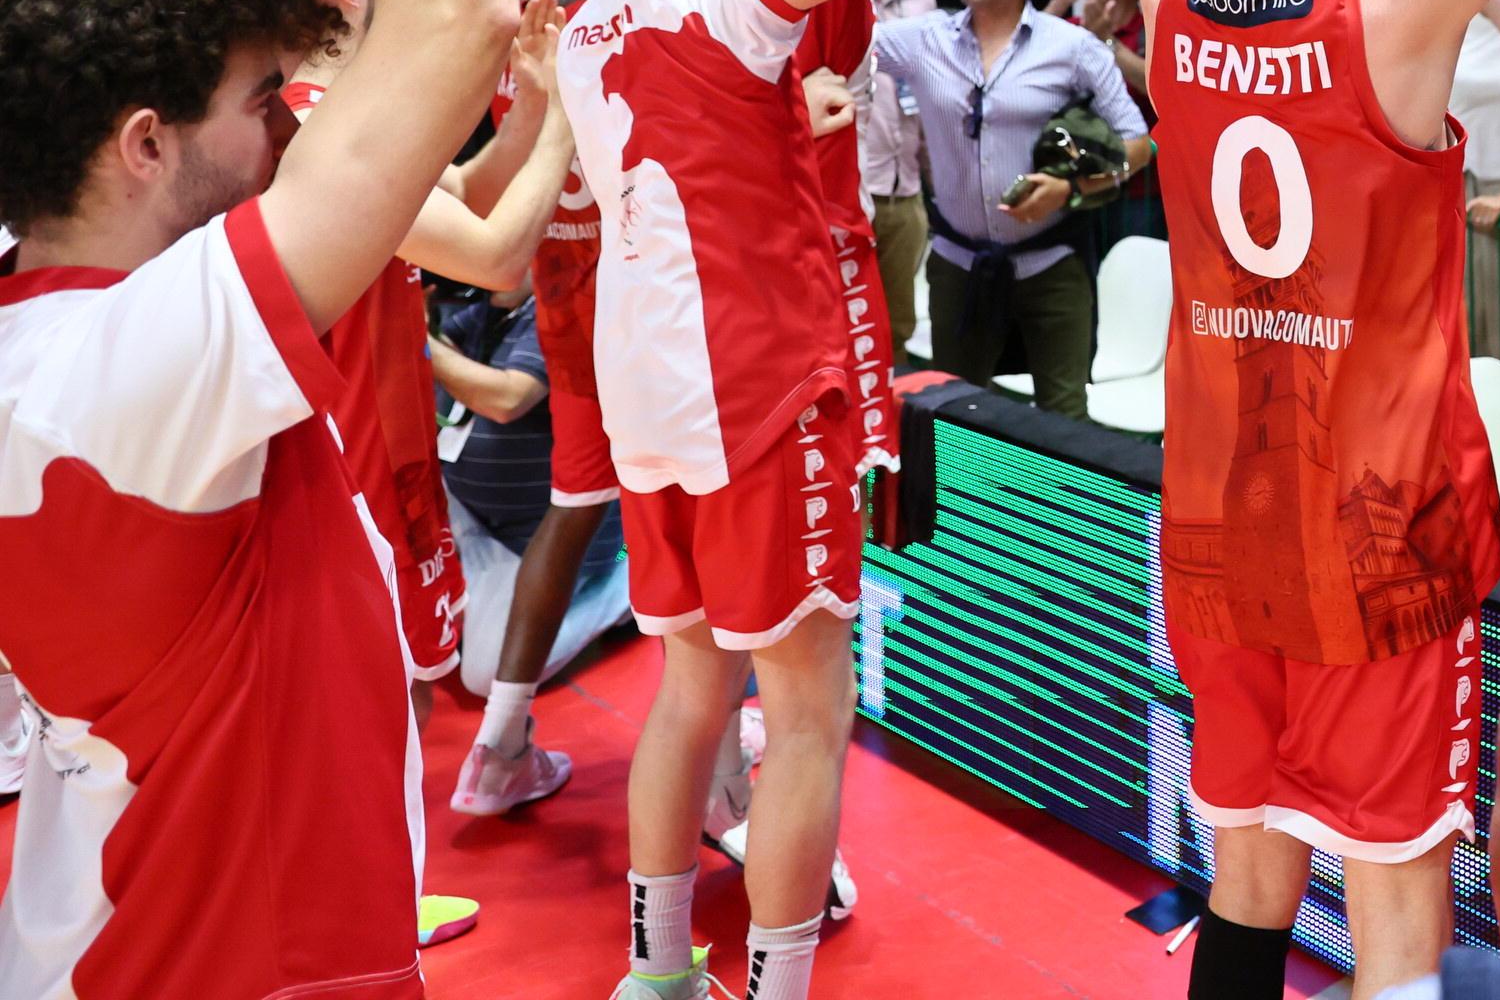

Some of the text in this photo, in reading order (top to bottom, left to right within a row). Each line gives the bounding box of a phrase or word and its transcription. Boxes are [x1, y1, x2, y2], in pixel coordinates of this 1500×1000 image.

[1174, 32, 1333, 95] BENETTI
[1210, 114, 1313, 279] 0
[1207, 307, 1354, 351] NUOVACOMAUT
